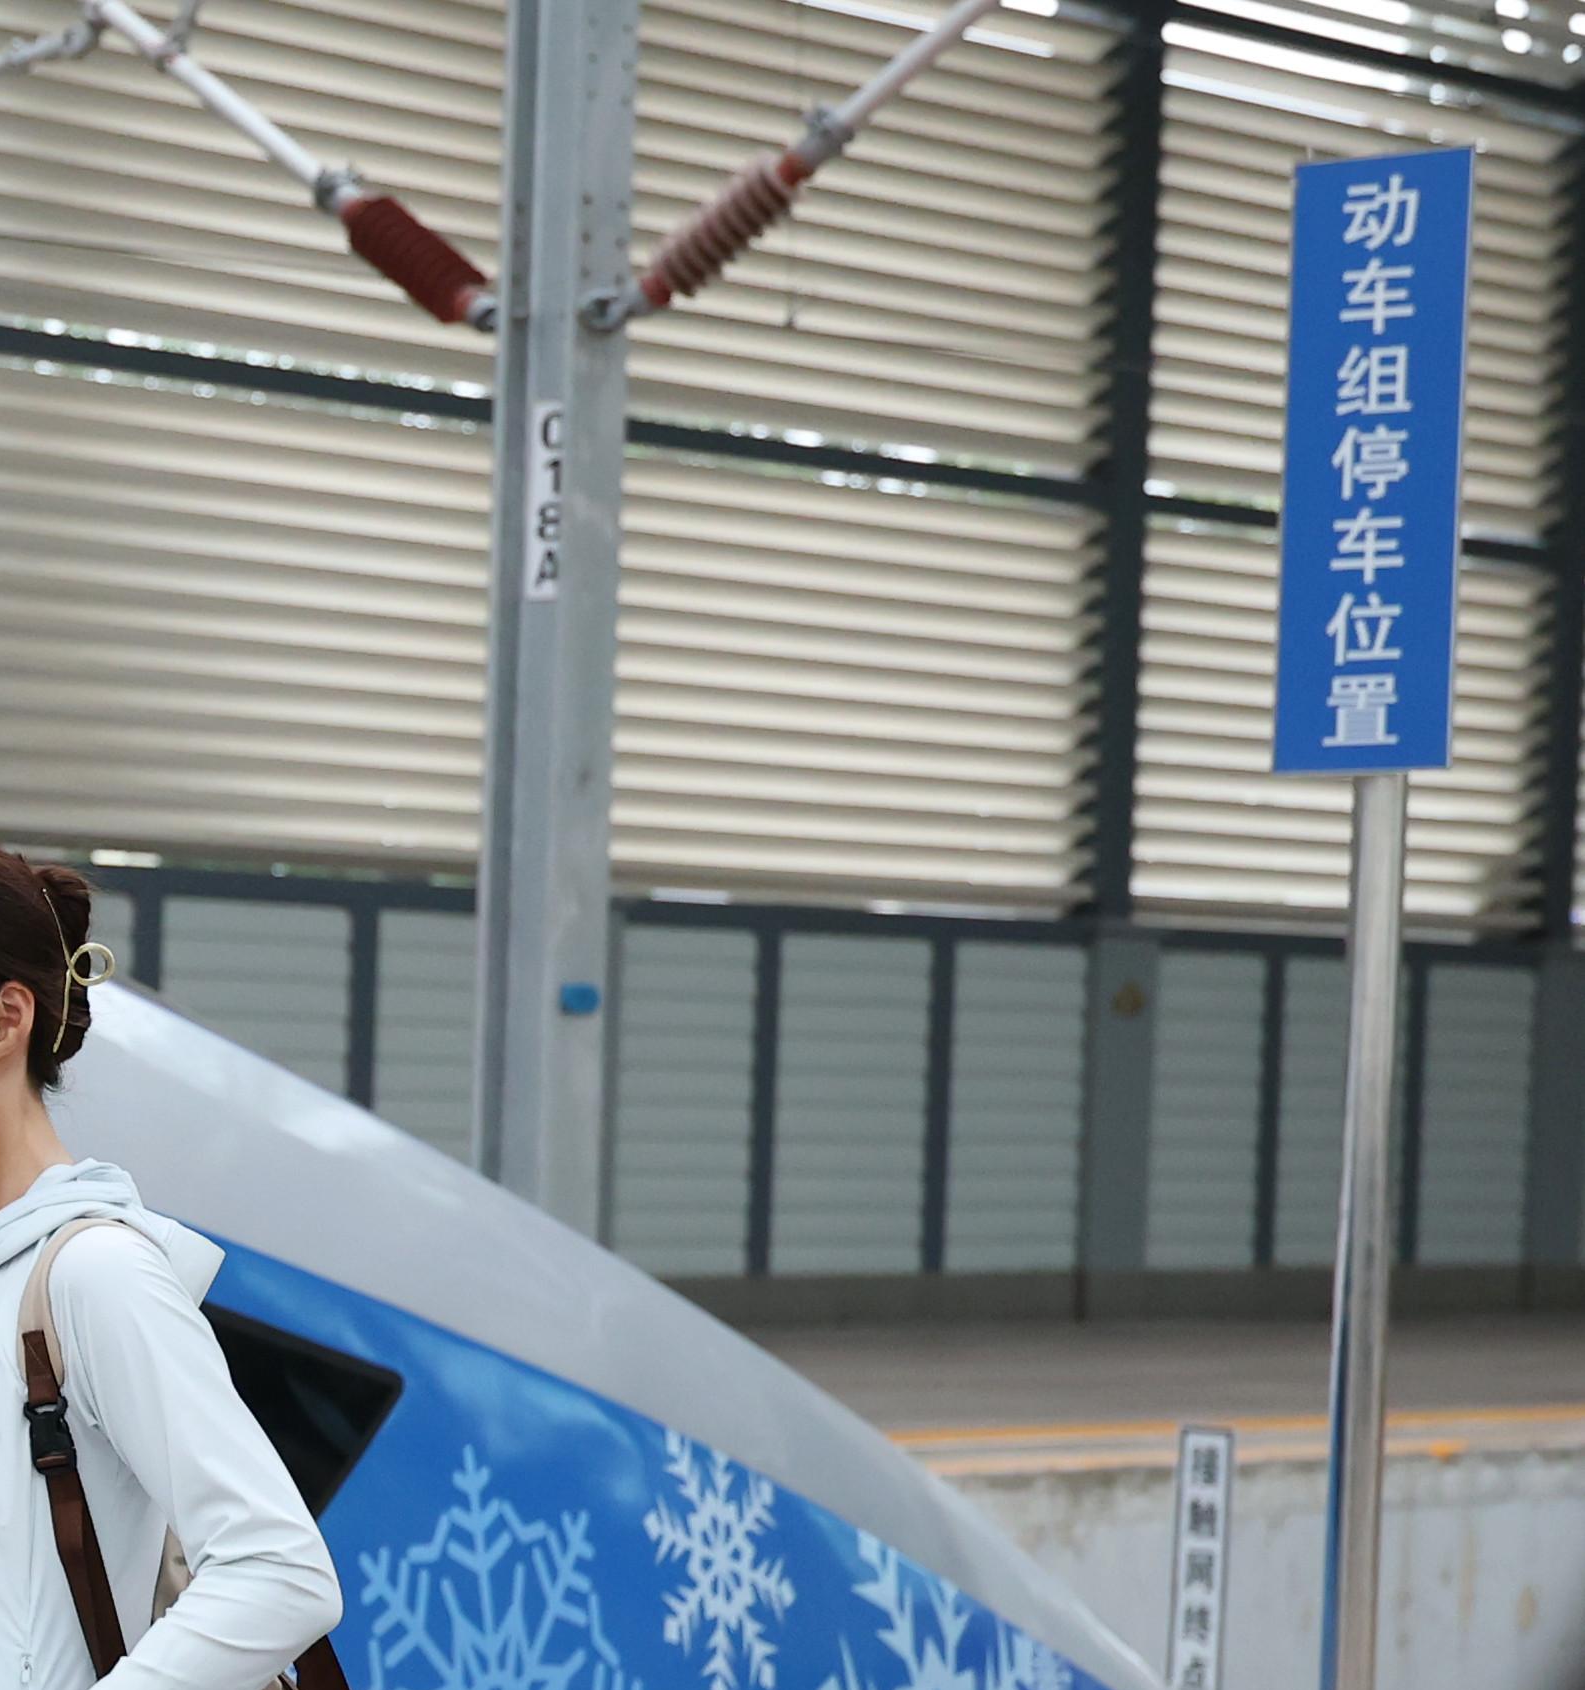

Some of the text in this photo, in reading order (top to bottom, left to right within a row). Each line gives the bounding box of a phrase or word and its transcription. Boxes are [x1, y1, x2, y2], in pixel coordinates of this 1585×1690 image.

[1322, 174, 1419, 748] 动车组停车位置
